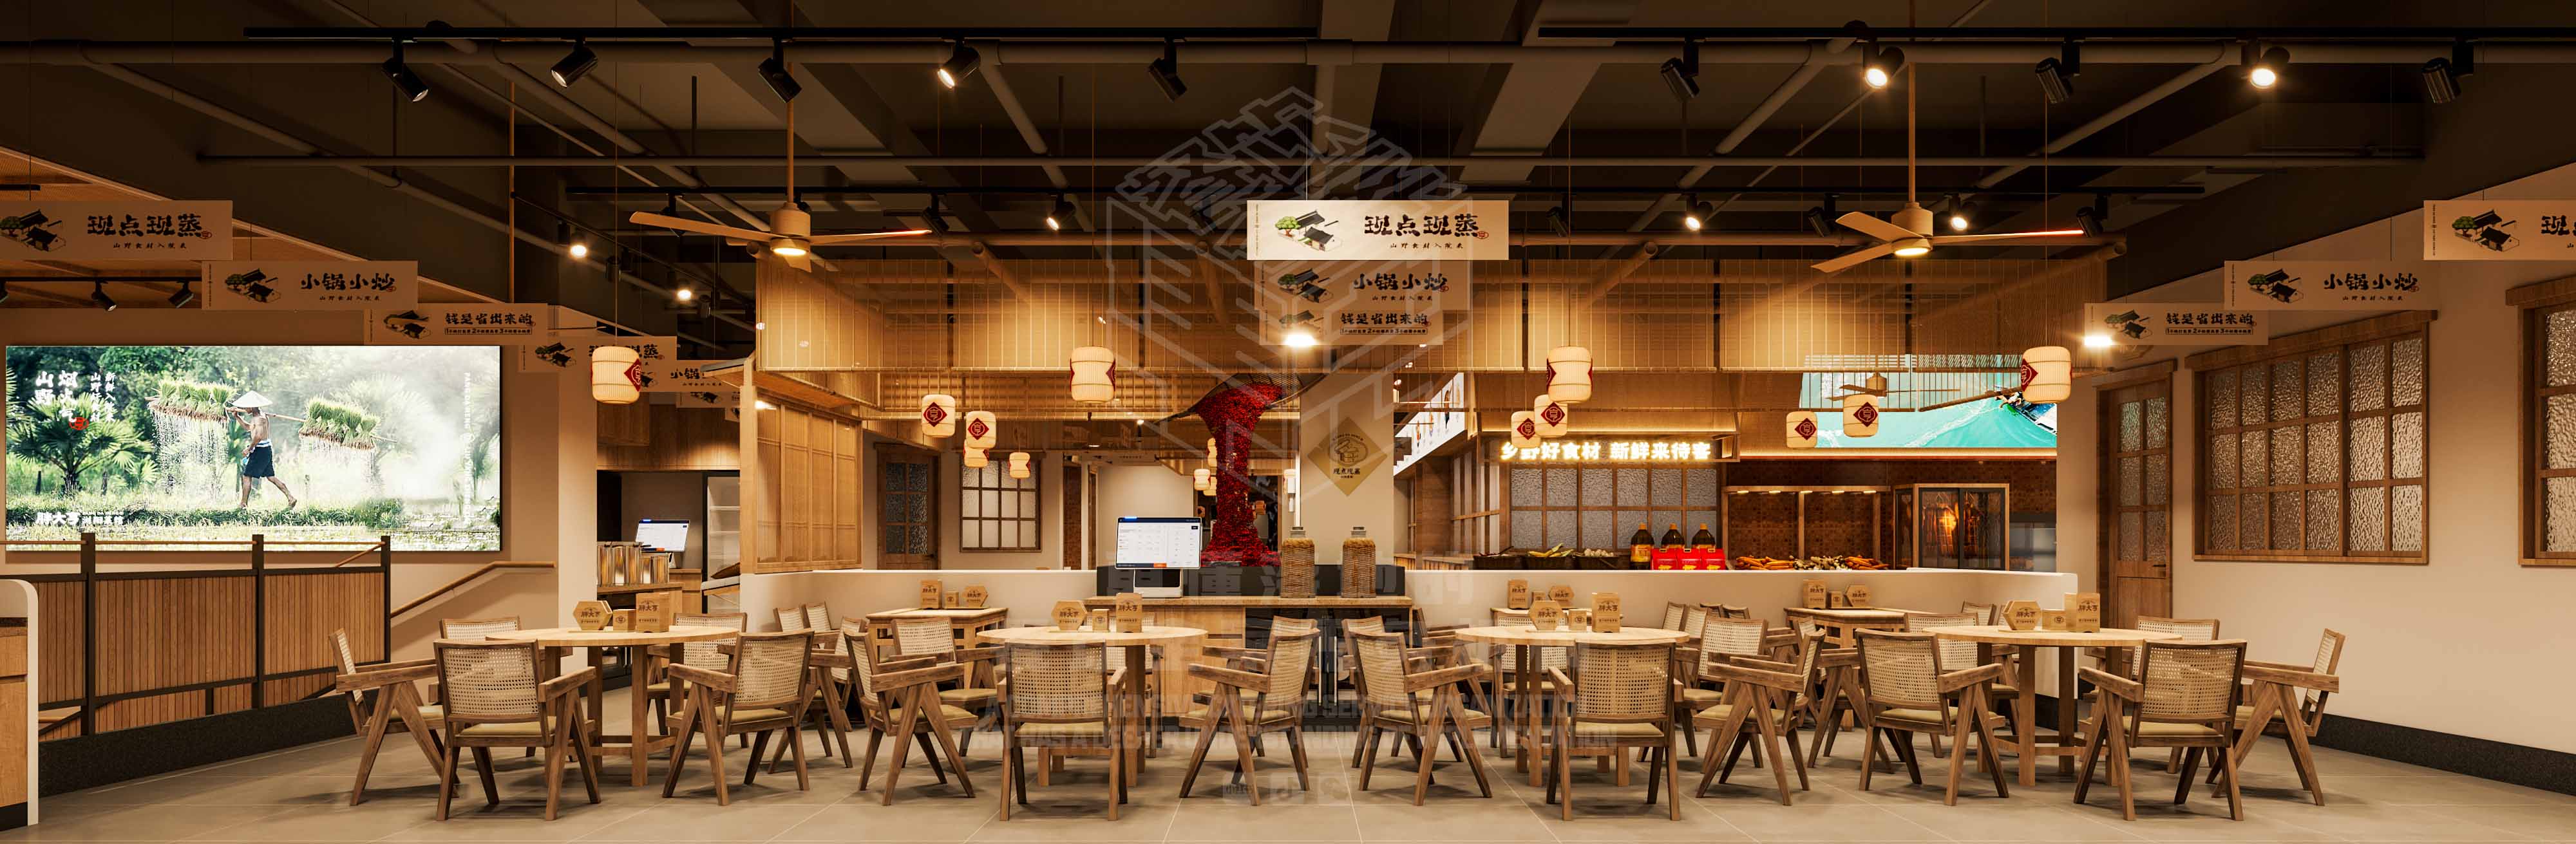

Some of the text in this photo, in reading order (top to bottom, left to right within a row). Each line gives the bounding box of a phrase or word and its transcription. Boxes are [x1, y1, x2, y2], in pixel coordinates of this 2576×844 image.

[88, 213, 202, 238] 现点现蒸
[1364, 213, 1479, 238] 现点现蒸
[2541, 214, 2576, 237] 现
[301, 272, 395, 292] 小锅小炒
[1354, 272, 1448, 292] 小锅小炒
[2324, 272, 2418, 292] 小锅小炒
[446, 313, 533, 326] 钱是省出来的
[1341, 312, 1428, 326] 钱是省出来的
[2166, 312, 2253, 326] 钱是省出来的
[35, 371, 55, 405] 山野
[58, 370, 79, 422] 烟火气
[1609, 442, 1711, 460] 新鲜来待客
[35, 511, 80, 525] 胖大亨
